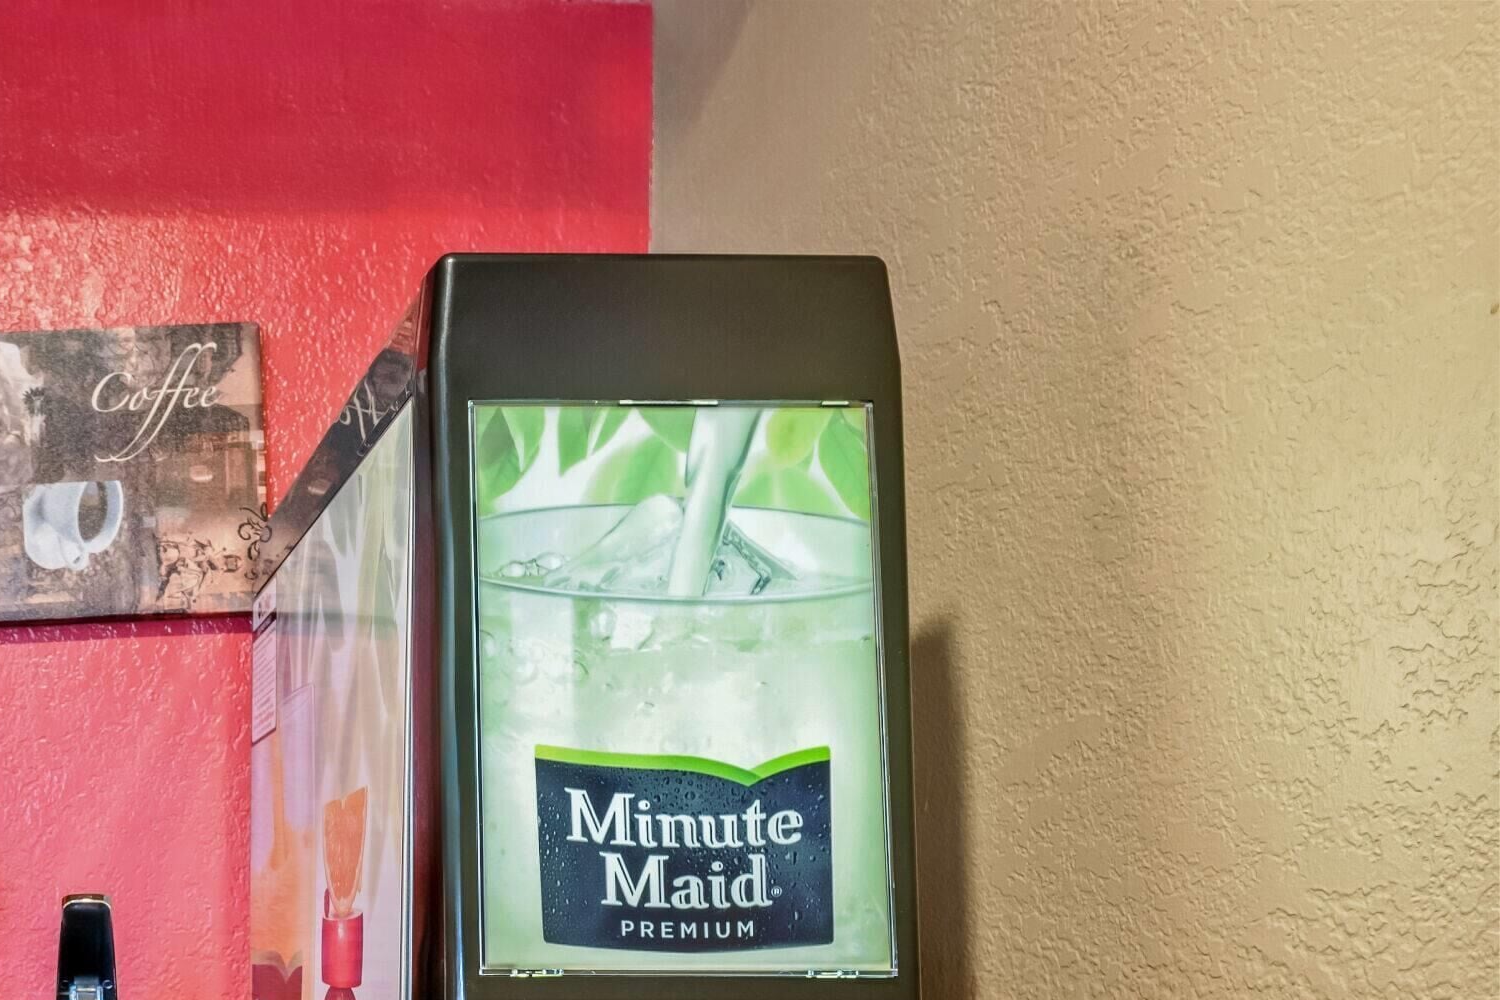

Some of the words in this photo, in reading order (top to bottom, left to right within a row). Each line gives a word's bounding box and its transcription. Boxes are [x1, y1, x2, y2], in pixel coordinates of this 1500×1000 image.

[91, 342, 217, 462] Coffee
[564, 787, 803, 849] Minute
[600, 851, 773, 910] Maid
[621, 920, 754, 938] PREMIUM
